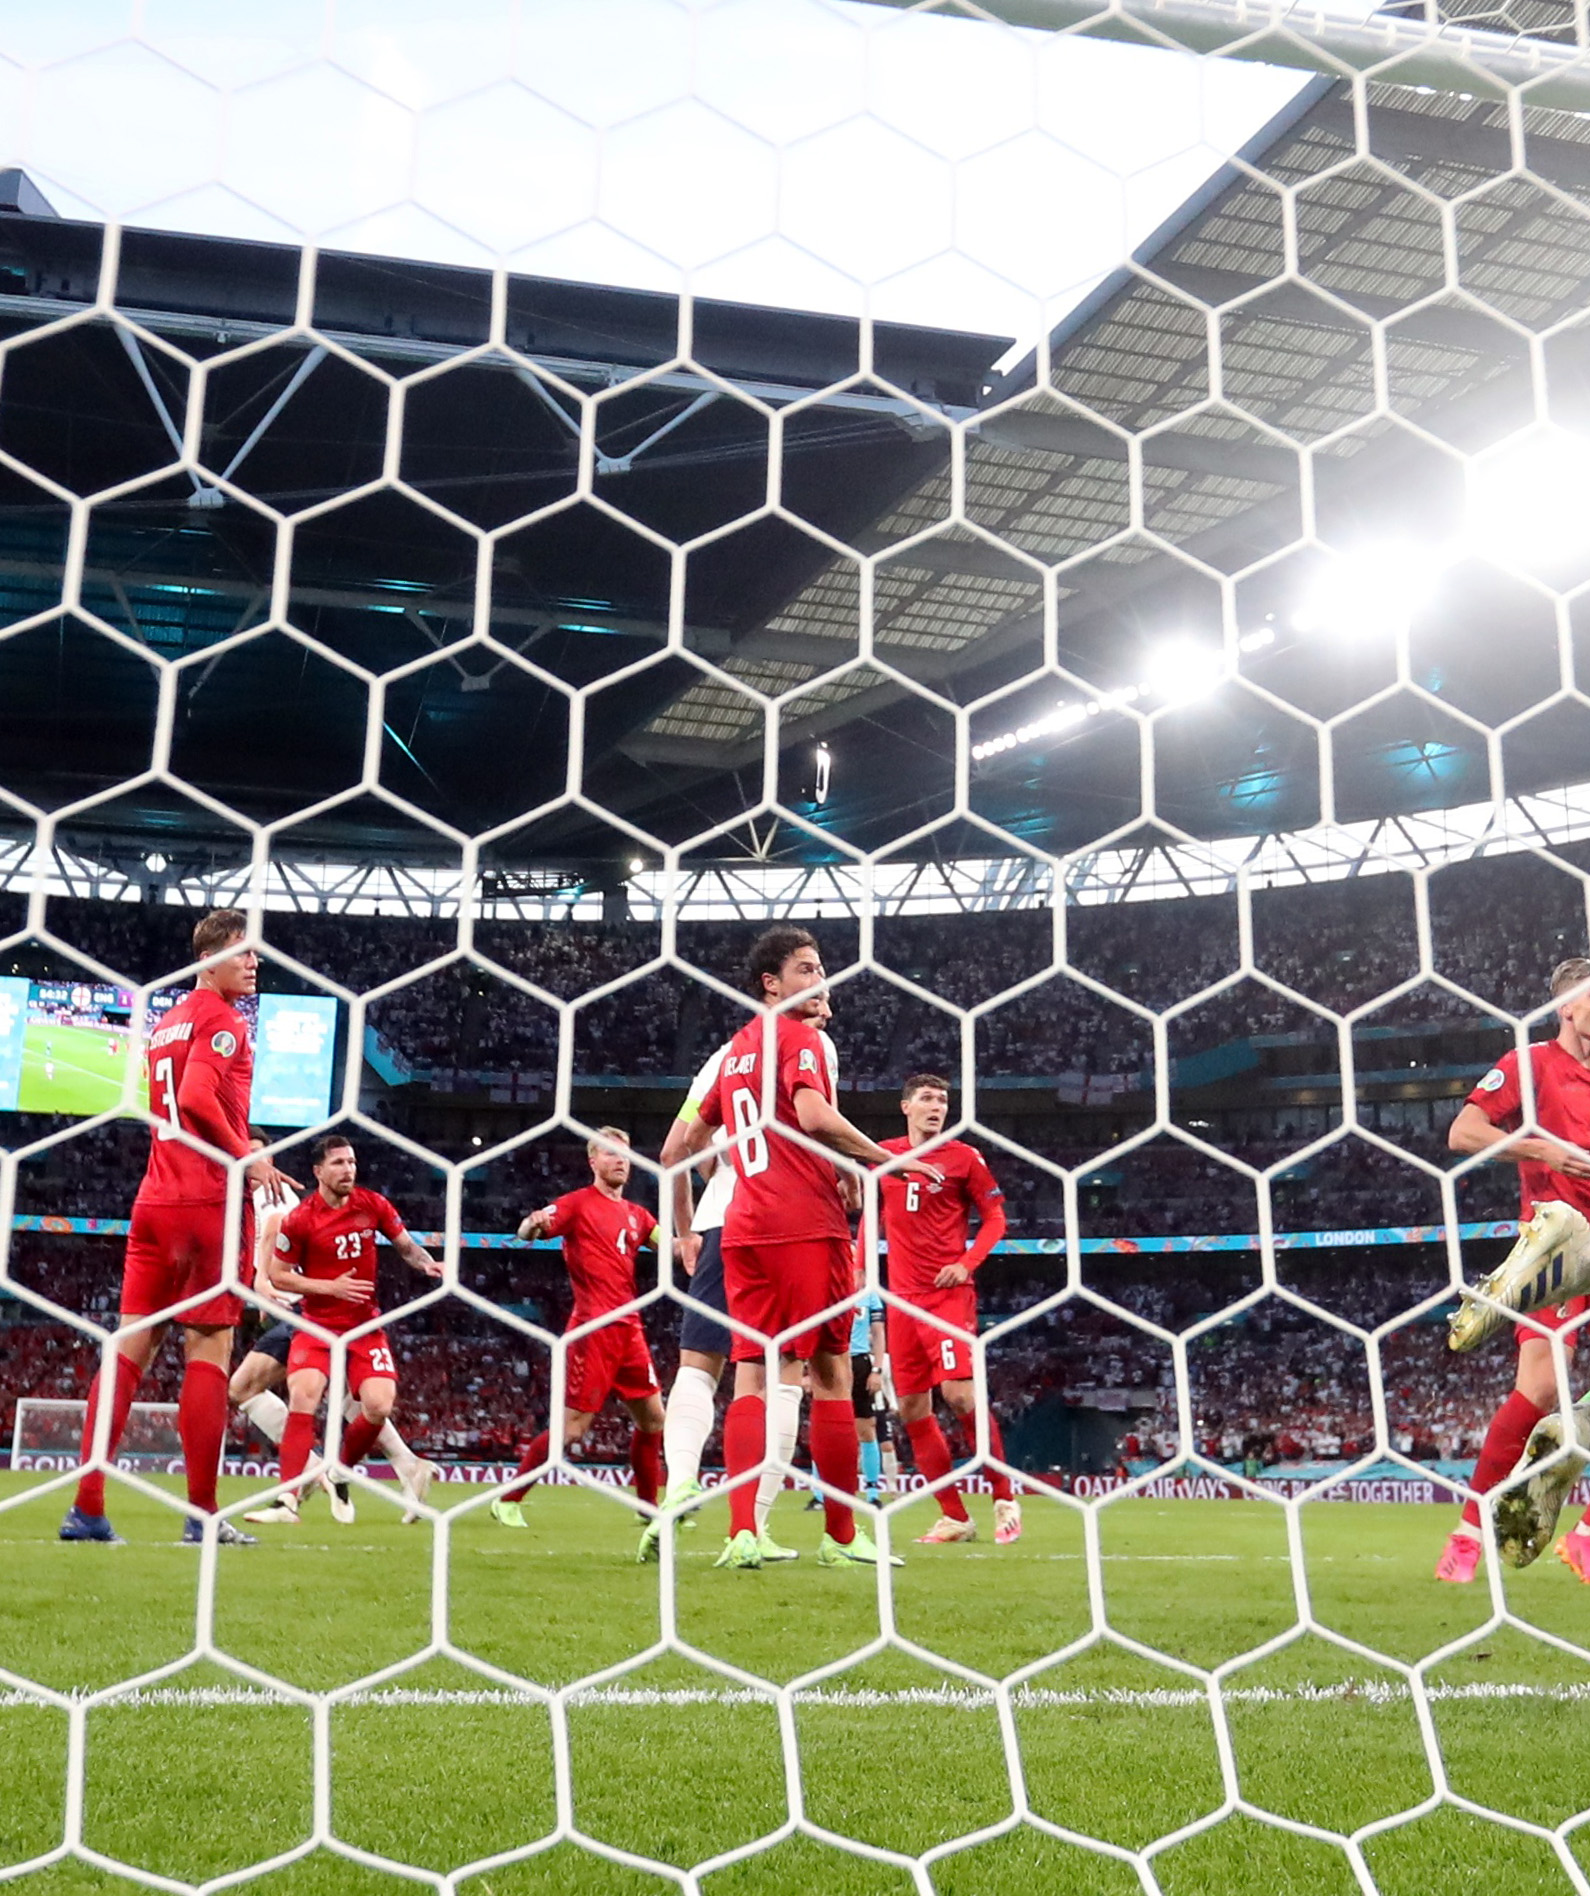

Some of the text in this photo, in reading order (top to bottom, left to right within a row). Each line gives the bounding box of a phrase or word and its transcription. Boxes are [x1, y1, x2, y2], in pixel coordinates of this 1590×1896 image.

[155, 1056, 181, 1141] 3
[732, 1087, 769, 1178] 8
[905, 1181, 920, 1212] 6
[334, 1231, 362, 1260] 23
[616, 1228, 627, 1255] 4
[1315, 1230, 1376, 1247] LONDON
[369, 1347, 396, 1373] 23
[941, 1339, 956, 1370] 6
[17, 1456, 83, 1472] GOIN
[1349, 1480, 1434, 1504] TOGETHER
